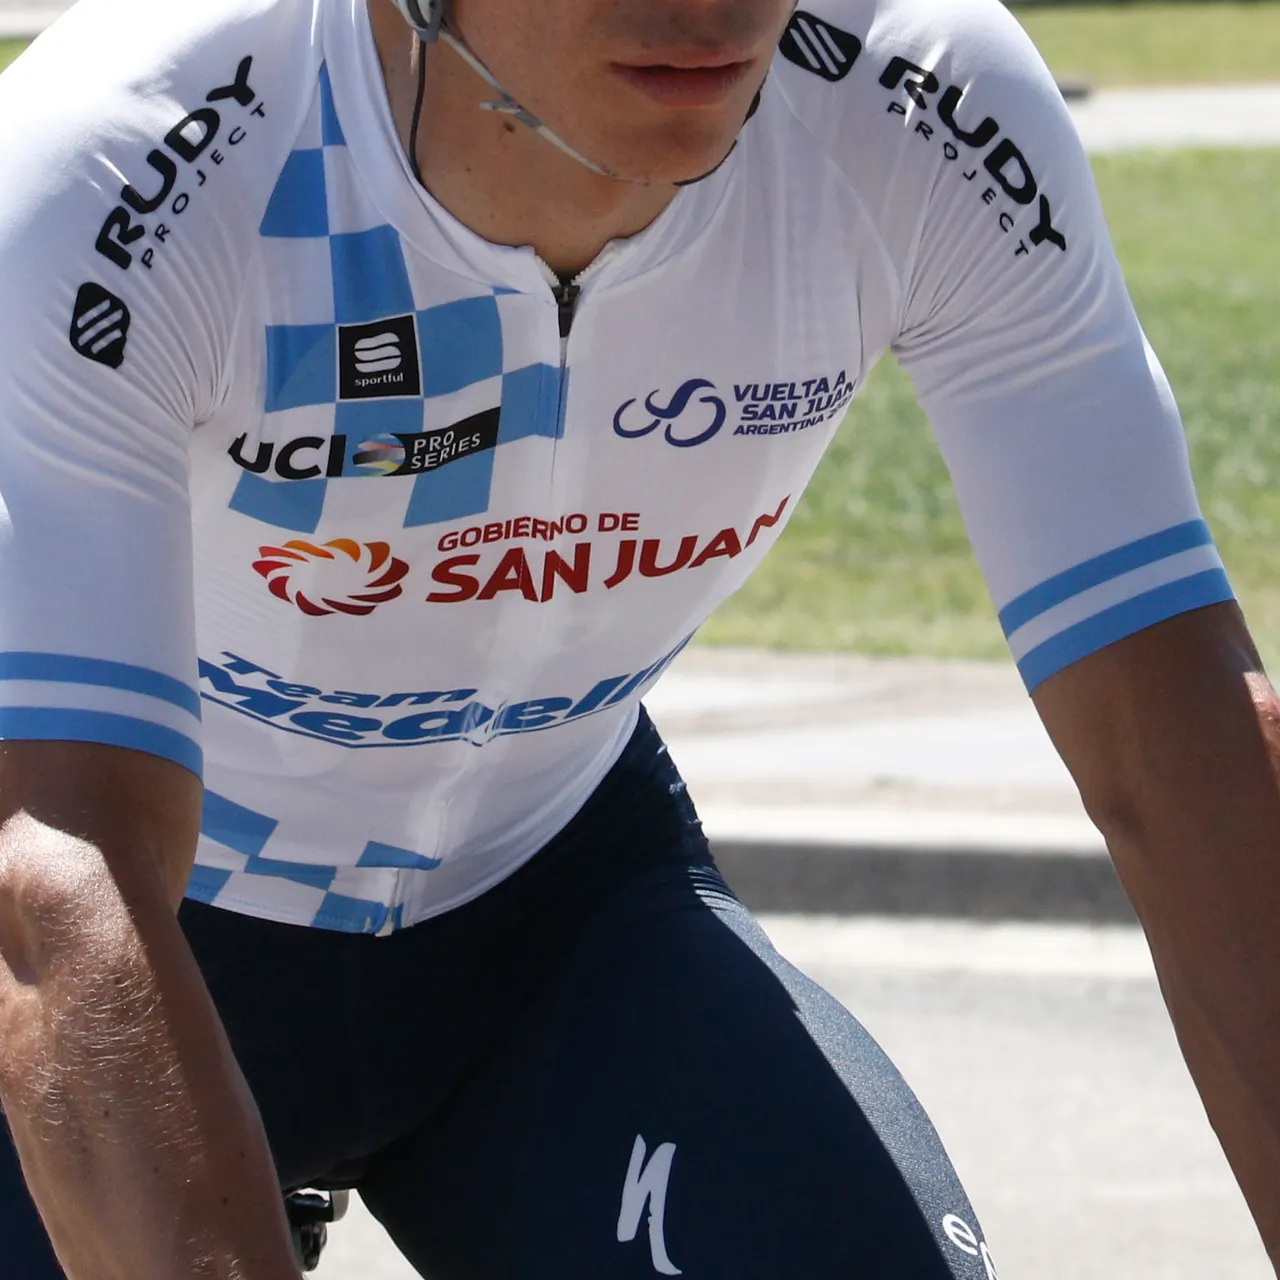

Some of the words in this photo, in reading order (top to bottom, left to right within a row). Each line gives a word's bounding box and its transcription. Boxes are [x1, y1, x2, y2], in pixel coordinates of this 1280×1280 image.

[95, 55, 256, 271] RUDY
[878, 55, 1067, 252] RUDY
[140, 101, 267, 270] PROJECT
[886, 100, 1029, 257] PROJECT
[354, 372, 404, 388] sportful
[733, 376, 829, 402] VUELTA
[833, 369, 846, 392] A
[740, 402, 798, 421] SAN
[802, 379, 858, 417] JUAN
[413, 430, 455, 454] PRO
[732, 413, 824, 436] ARGENTINA
[227, 432, 347, 480] UCI
[410, 432, 482, 470] SERIES
[425, 542, 592, 603] SAN
[602, 494, 792, 590] JUAN
[437, 514, 588, 552] GOBIERNO
[597, 512, 641, 533] DE
[221, 651, 478, 708] Team
